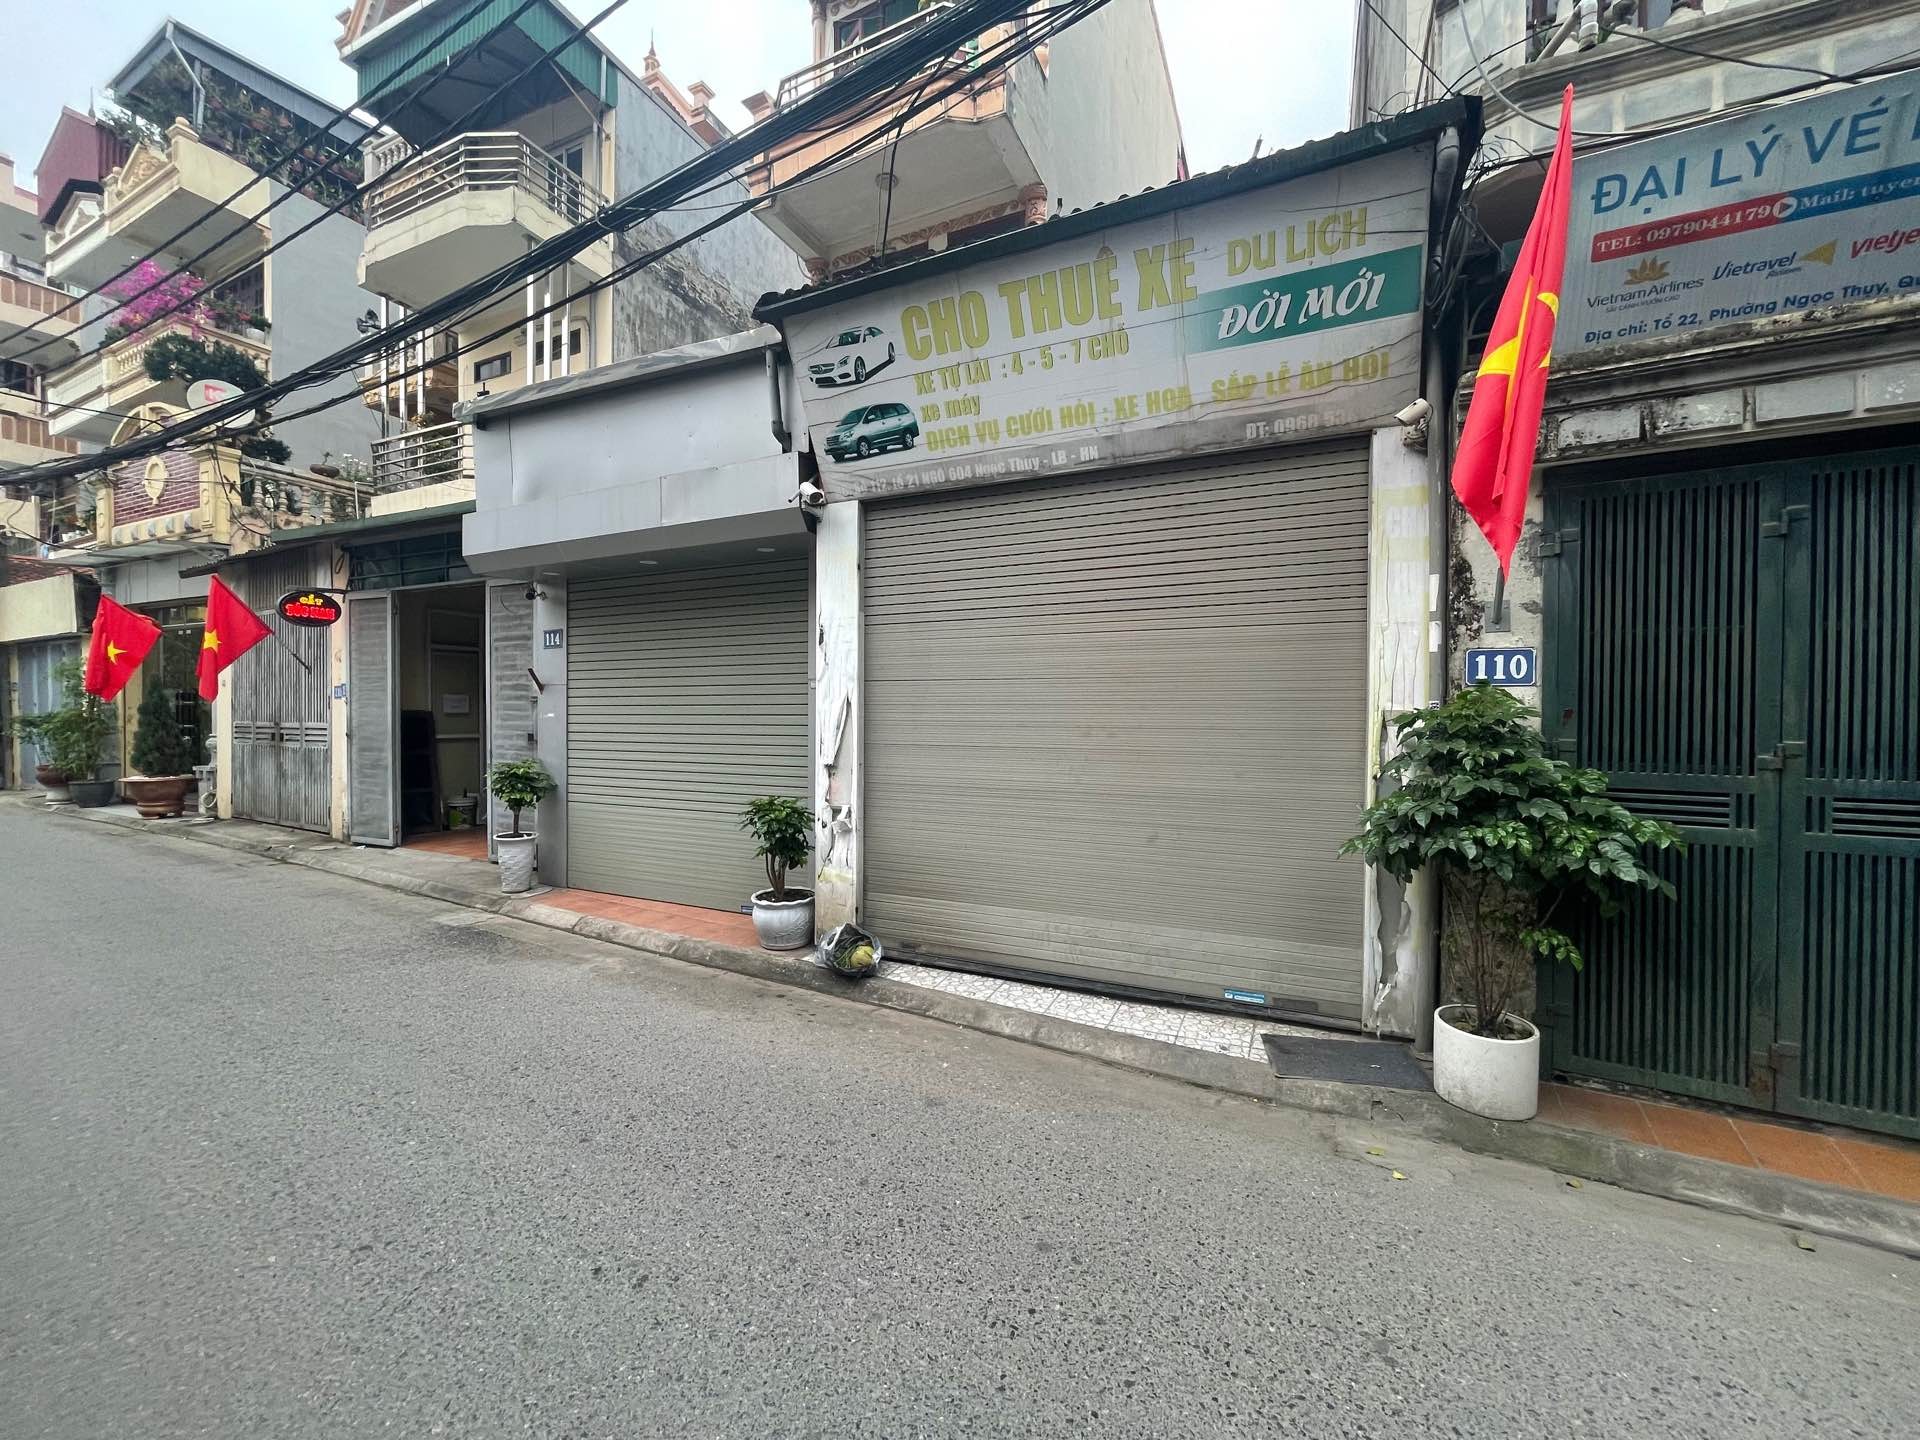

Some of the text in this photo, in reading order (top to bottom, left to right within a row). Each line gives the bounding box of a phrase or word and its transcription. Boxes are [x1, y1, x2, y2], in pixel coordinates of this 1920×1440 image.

[1590, 156, 1687, 214] ĐẠI
[1710, 124, 1783, 188] LÝ
[1802, 95, 1888, 165] VÉ
[1800, 188, 1856, 210] Mail:
[1597, 203, 1772, 253] TEL: 0979044179
[900, 207, 1368, 361] CHO THUÊ XE DU LỊCH
[1712, 251, 1797, 281] Vietravel
[1218, 266, 1386, 341] ĐỜI MỚI
[1585, 330, 1611, 345] Địa
[1617, 319, 1648, 339] chỉ:
[1653, 312, 1673, 331] Tổ
[1678, 313, 1702, 327] 22,
[1709, 300, 1778, 321] Phường
[1783, 290, 1834, 309] Ngọc
[914, 370, 936, 396] XE
[936, 360, 961, 392] TỰ
[966, 356, 992, 386] LÁI
[1011, 351, 1024, 376] 4
[1039, 344, 1055, 371] 5
[1070, 337, 1083, 365] 7
[1087, 321, 1130, 361] CHỖ
[920, 393, 982, 424] xe máy
[925, 424, 971, 454] DỊCH
[974, 418, 1001, 445] VỤ
[1113, 394, 1140, 421] XE
[1145, 383, 1193, 413] HOA
[949, 464, 973, 482] 604
[1051, 448, 1068, 466] LB
[1079, 445, 1099, 462] HN
[546, 632, 560, 646] 114
[1475, 654, 1528, 680] 110
